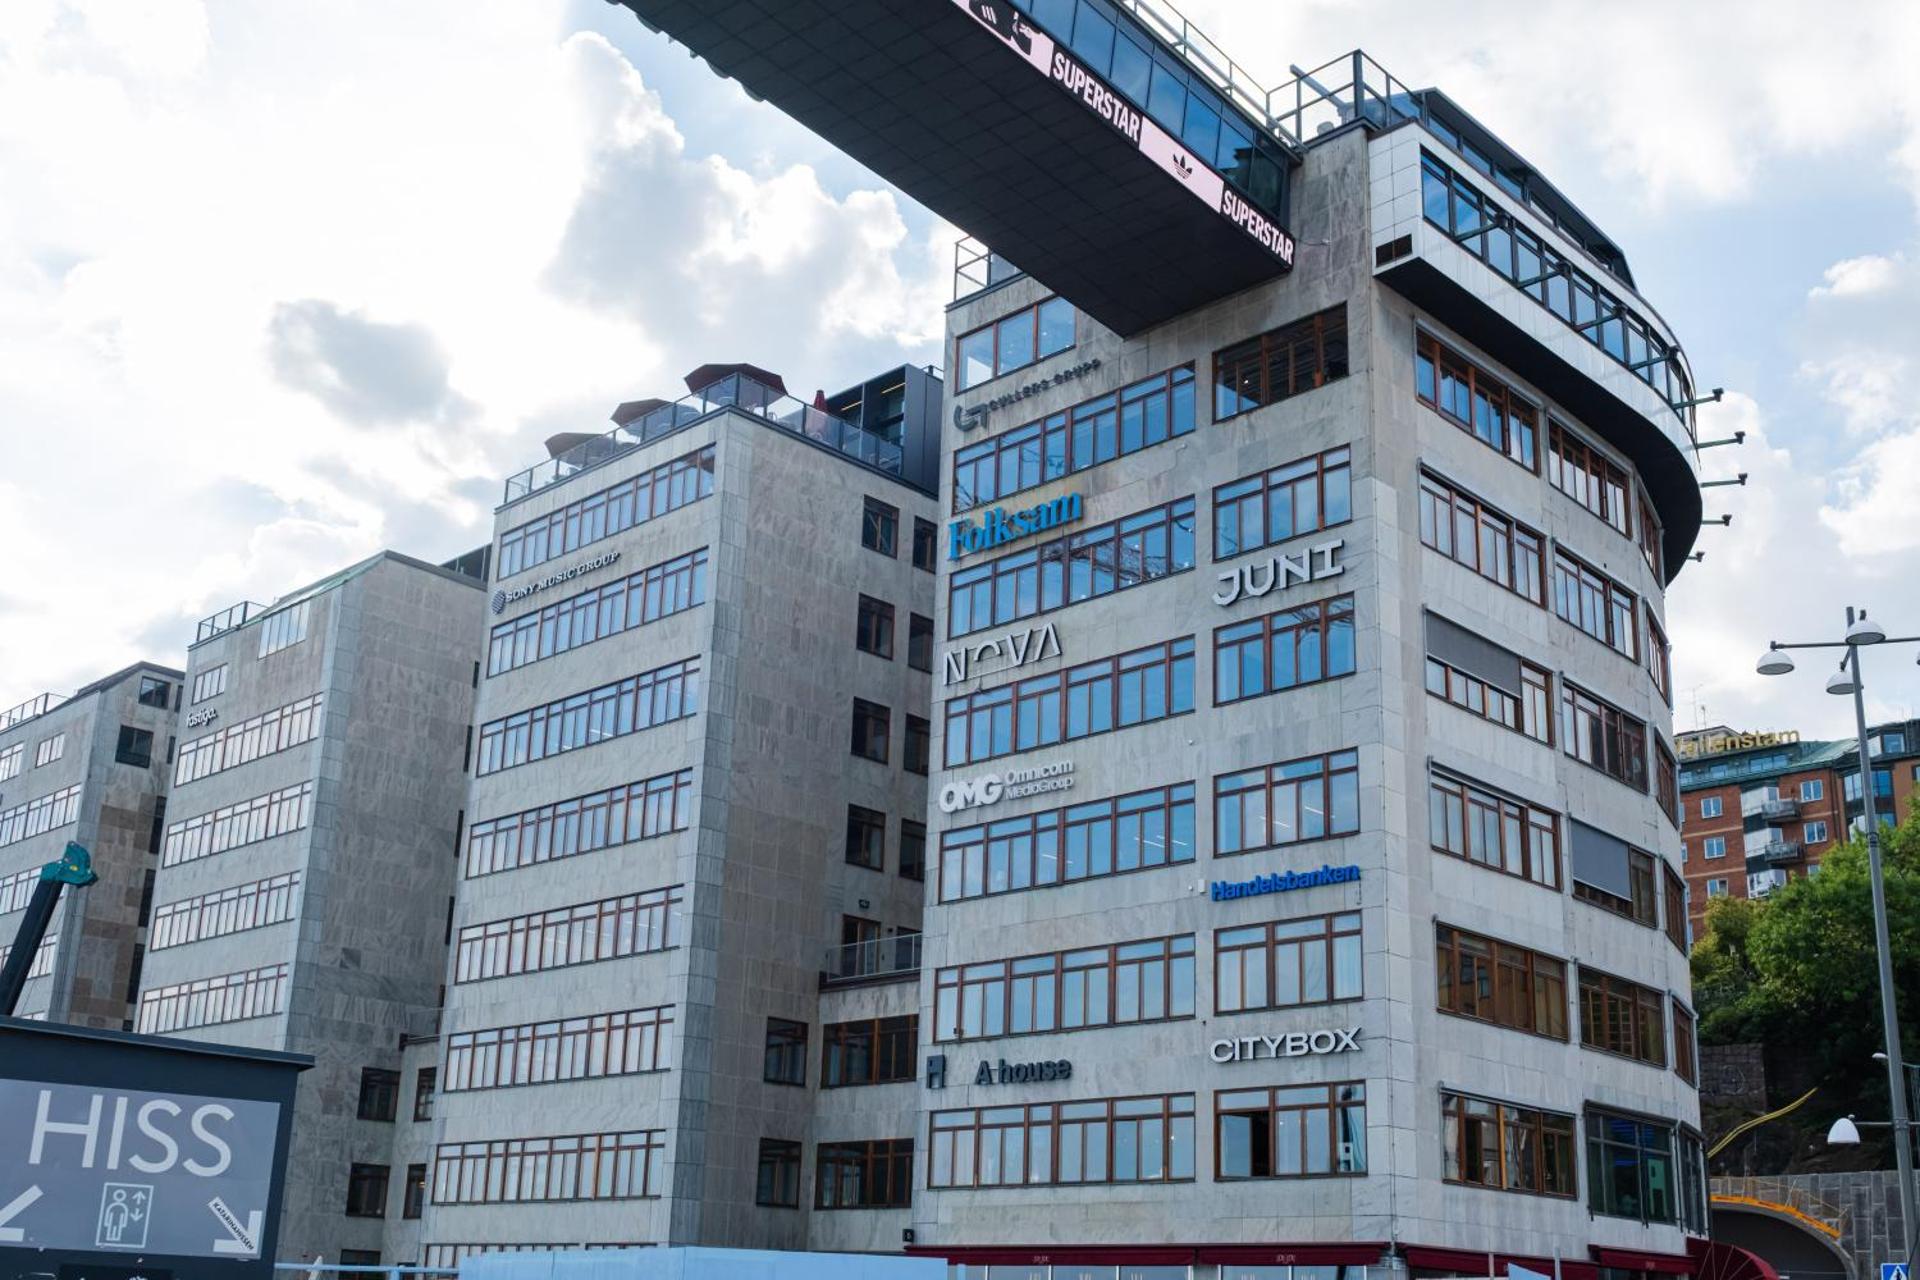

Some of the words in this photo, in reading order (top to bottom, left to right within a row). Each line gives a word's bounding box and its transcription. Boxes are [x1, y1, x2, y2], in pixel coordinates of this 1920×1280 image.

[1053, 52, 1141, 142] SUPERSTAR
[1223, 190, 1294, 264] SUPERSTAR
[948, 492, 1083, 561] Folksam
[505, 586, 538, 602] SONY
[538, 569, 577, 592] MUSIC
[577, 551, 620, 576] GROUP
[1212, 539, 1345, 607] JUNI
[943, 622, 1063, 686] NOVA
[939, 774, 1003, 813] OMG
[1004, 760, 1073, 785] Omnicom
[1211, 864, 1361, 901] Handelsbanken
[1210, 1027, 1362, 1063] CITYBOX
[975, 1060, 993, 1085] A
[999, 1058, 1072, 1084] house
[28, 1090, 235, 1177] HISS
[212, 1202, 254, 1250] KATARINAHISSEN
